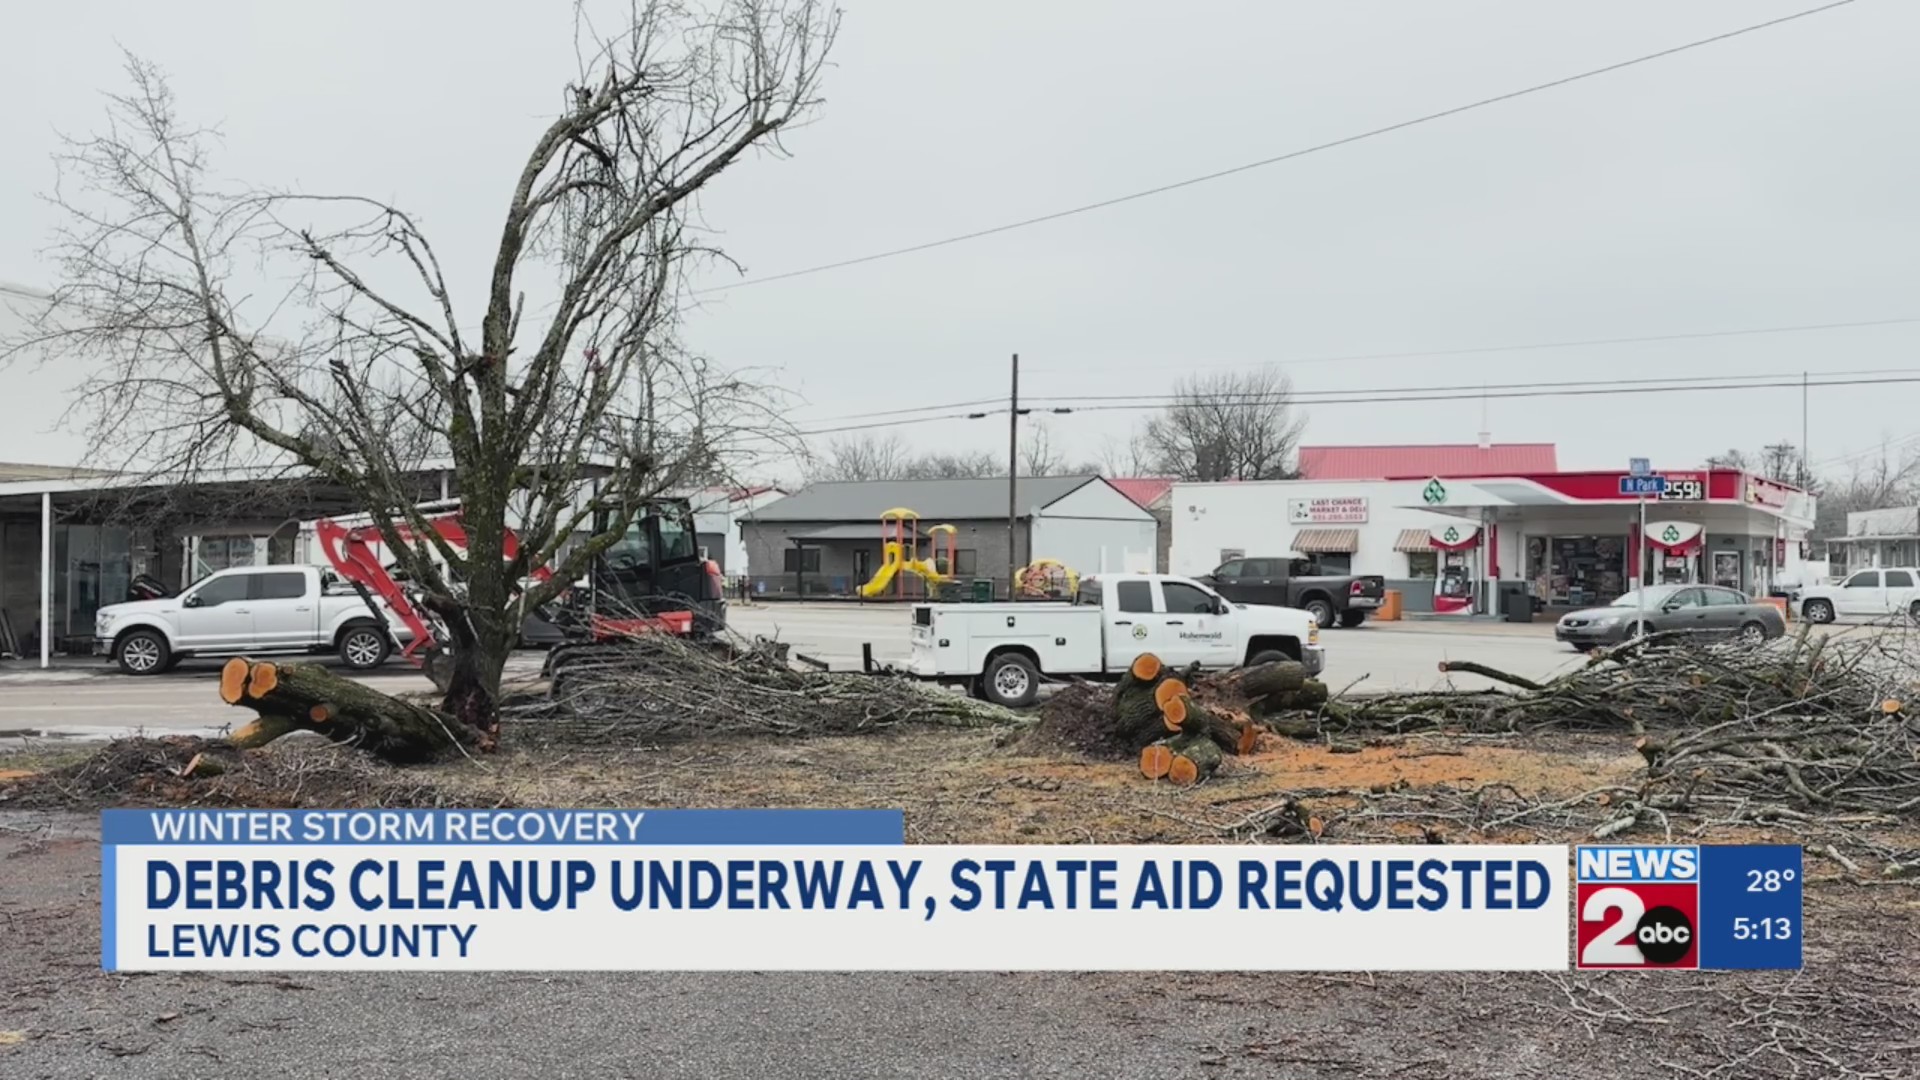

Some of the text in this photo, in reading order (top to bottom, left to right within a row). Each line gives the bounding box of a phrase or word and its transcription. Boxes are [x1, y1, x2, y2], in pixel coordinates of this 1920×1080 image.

[1626, 478, 1658, 491] N Park
[1331, 498, 1362, 506] CHANCE
